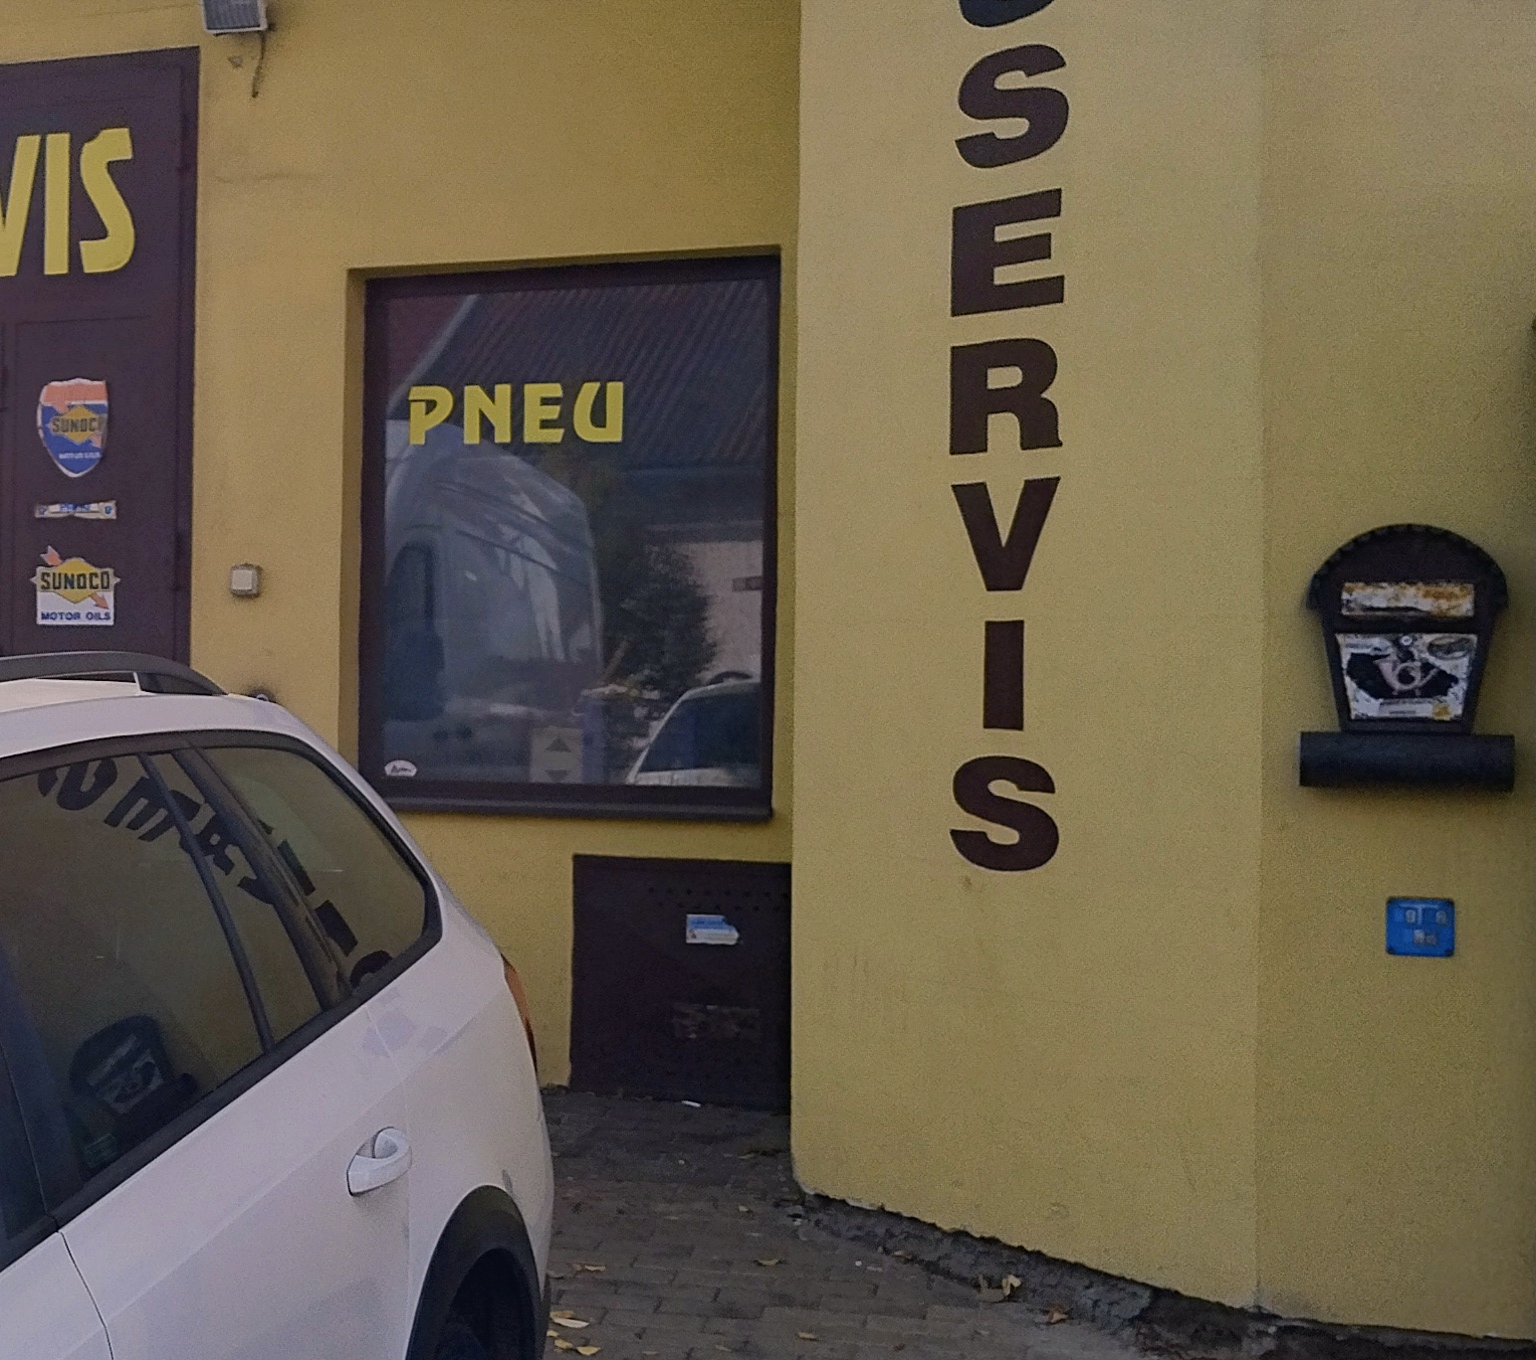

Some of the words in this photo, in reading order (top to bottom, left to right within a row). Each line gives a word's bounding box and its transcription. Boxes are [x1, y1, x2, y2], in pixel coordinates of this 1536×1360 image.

[407, 380, 624, 445] PNEU
[40, 570, 111, 591] SUNOCO
[41, 612, 81, 621] MOTOR
[85, 611, 111, 621] OILS
